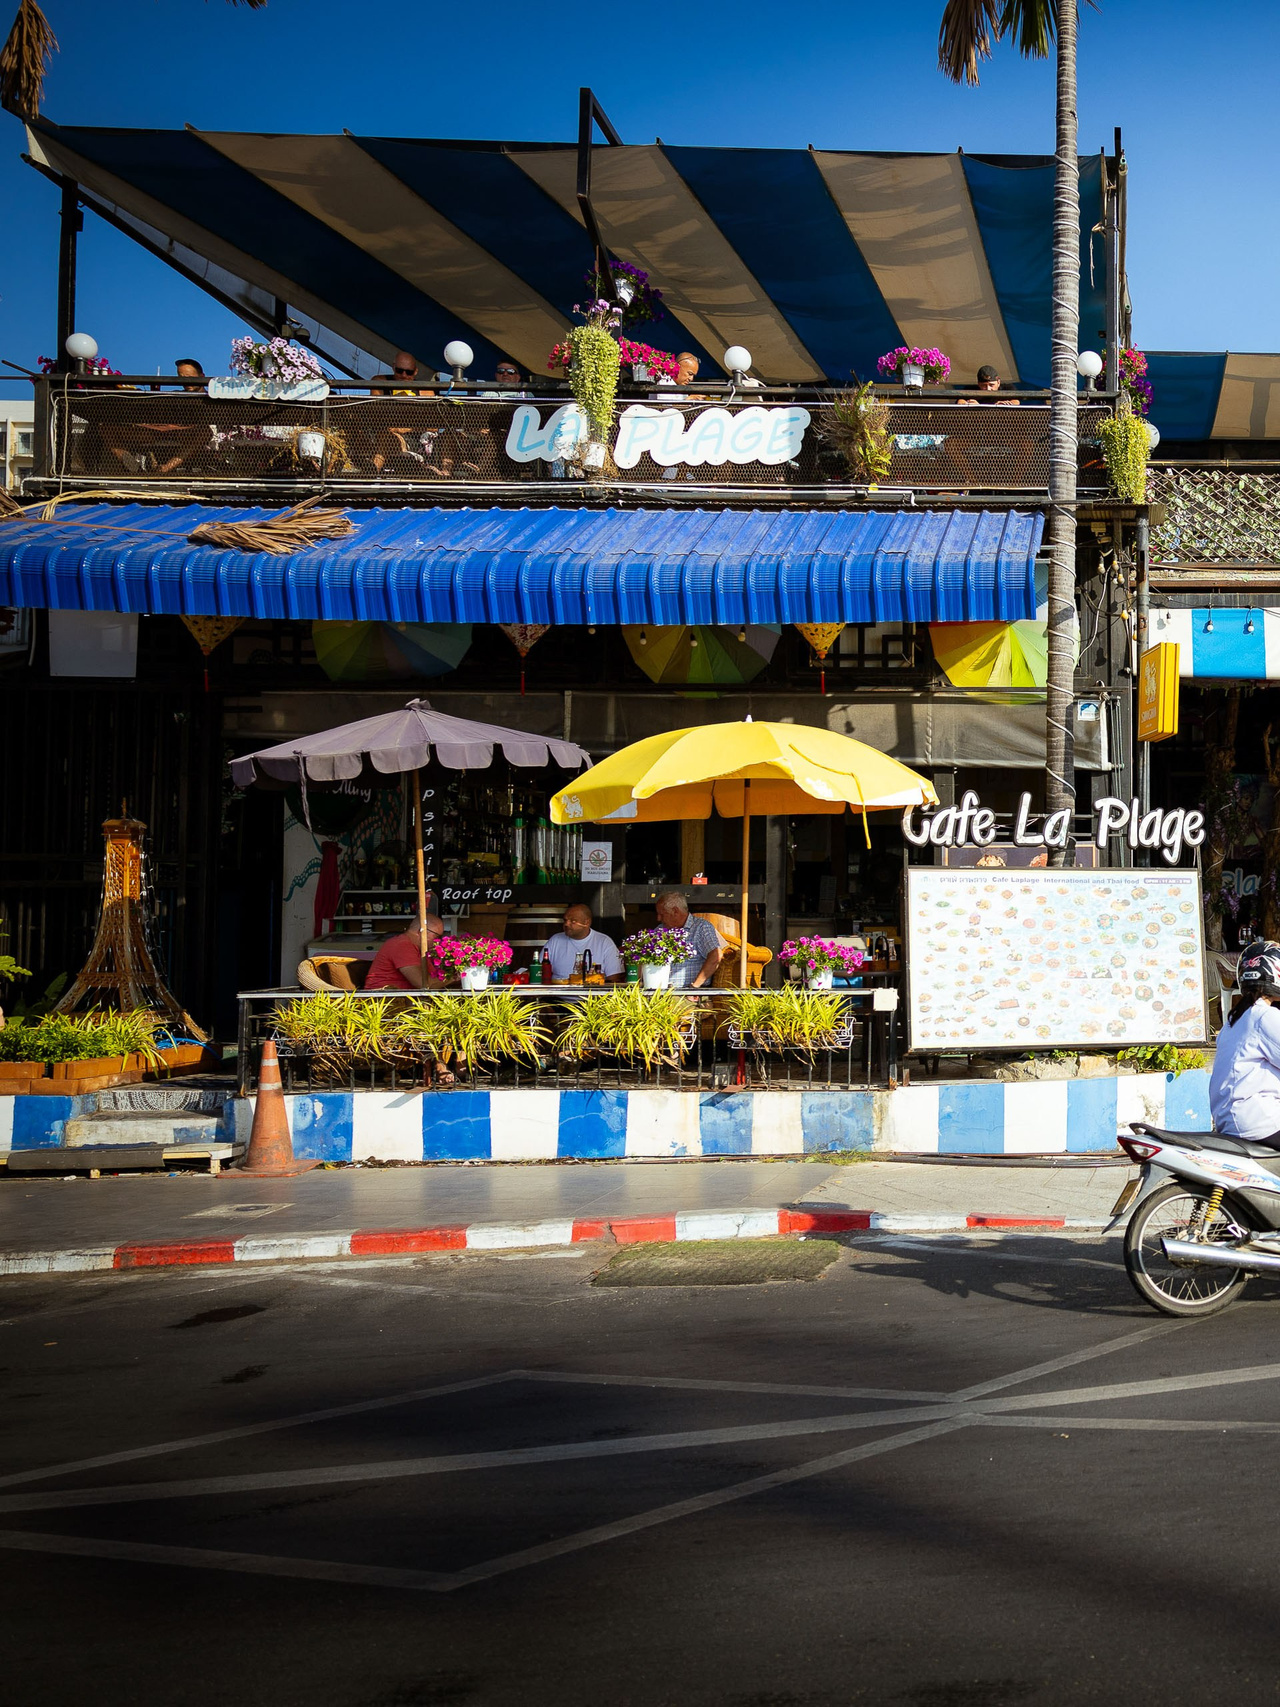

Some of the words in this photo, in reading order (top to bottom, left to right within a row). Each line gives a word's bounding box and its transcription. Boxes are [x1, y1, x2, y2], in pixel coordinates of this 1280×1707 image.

[516, 413, 581, 453] LA
[623, 415, 801, 459] PLAGE
[901, 789, 997, 849] Cafe
[1013, 790, 1073, 849] La
[1091, 796, 1207, 866] Plage
[441, 887, 481, 901] Roof
[485, 886, 513, 903] top
[1011, 877, 1040, 885] Laplage
